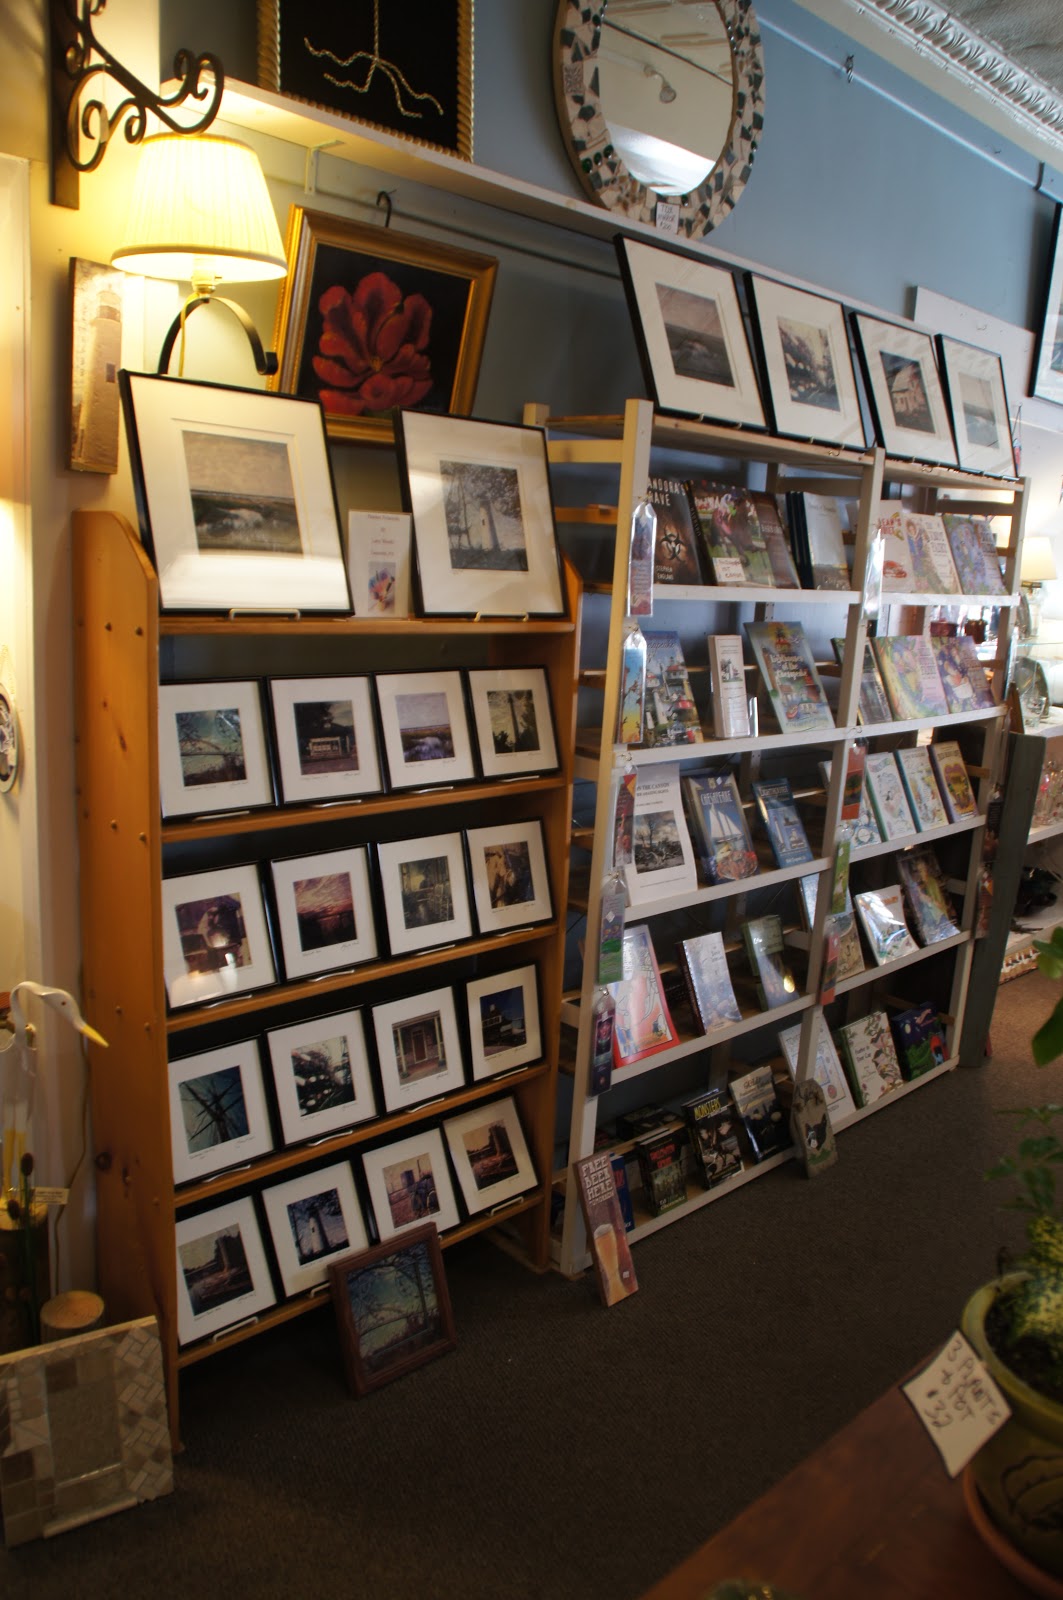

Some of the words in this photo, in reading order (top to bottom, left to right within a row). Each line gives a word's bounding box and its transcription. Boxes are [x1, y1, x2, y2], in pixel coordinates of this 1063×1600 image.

[581, 1155, 609, 1178] FREE
[584, 1167, 611, 1189] BEER
[587, 1179, 613, 1201] HERE
